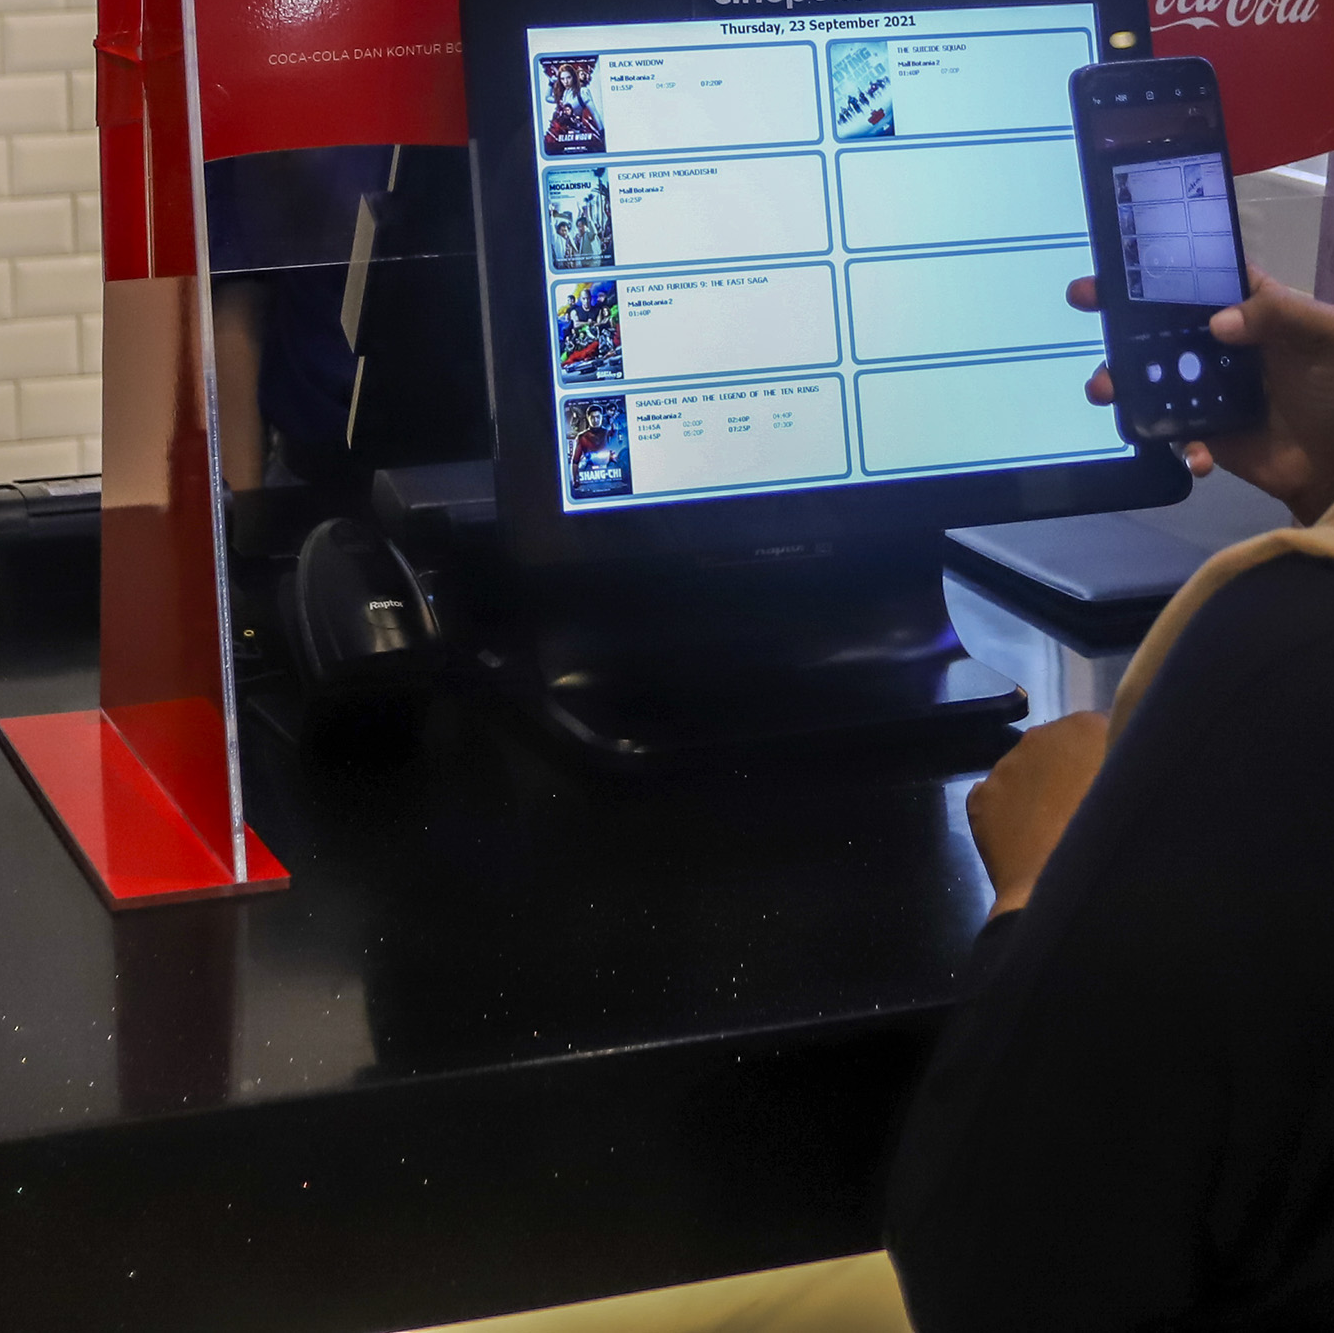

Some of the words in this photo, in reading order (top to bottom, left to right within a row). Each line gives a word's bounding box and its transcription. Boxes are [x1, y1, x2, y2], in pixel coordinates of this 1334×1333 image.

[720, 21, 785, 36] Thursday,
[789, 20, 806, 32] 23
[809, 16, 880, 33] September
[884, 15, 916, 28] 2021
[268, 49, 350, 65] COCA-COLA
[354, 47, 382, 60] DAN
[387, 43, 442, 58] KONTUR
[912, 45, 940, 53] SUICIDE
[942, 44, 967, 52] SQUAD
[608, 60, 633, 68] BLACK
[618, 171, 646, 180] ESCAPE
[649, 170, 670, 178] FROM
[672, 168, 718, 177] MOGADISHU
[549, 182, 591, 191] MOGADISHU
[626, 285, 645, 293] FAST
[648, 284, 664, 292] AND
[666, 282, 698, 291] FURIOUS
[710, 279, 724, 287] THE
[726, 278, 746, 286] FAST
[747, 276, 769, 284] SAGA
[635, 397, 677, 407] SHANG-CHI
[681, 395, 698, 404] AND
[702, 393, 715, 401] THE
[719, 391, 747, 401] LEGEND
[749, 390, 759, 398] OF
[763, 388, 776, 397] THE
[780, 387, 794, 395] TEN
[797, 385, 820, 394] RINGS
[579, 468, 622, 481] SHANG-CHI
